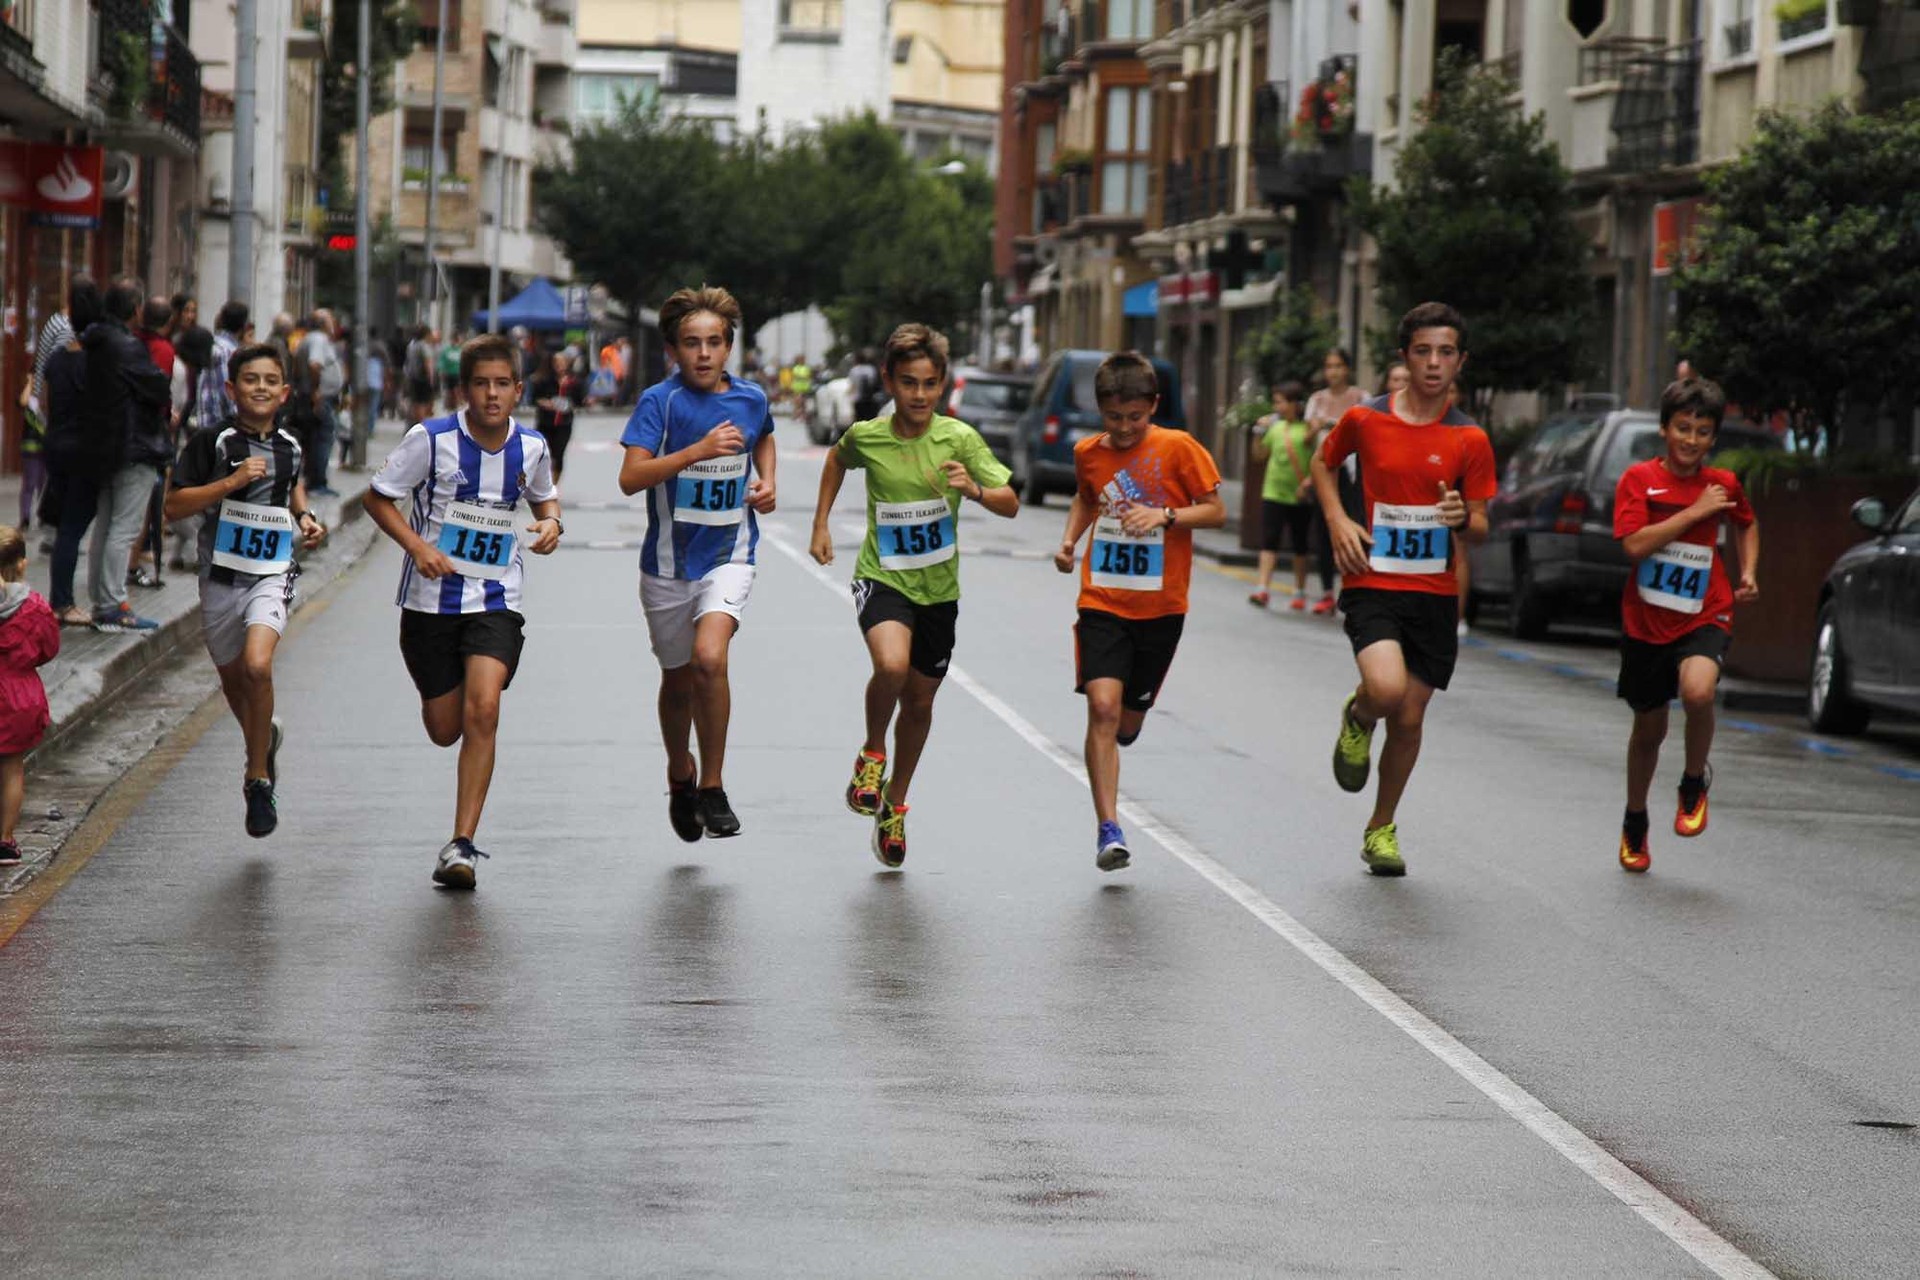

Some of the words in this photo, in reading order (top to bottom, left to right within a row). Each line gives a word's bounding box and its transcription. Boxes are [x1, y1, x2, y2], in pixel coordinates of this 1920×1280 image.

[691, 479, 737, 510] 150
[226, 508, 260, 521] ZUNBELTZ
[451, 510, 485, 525] ZUNBELTZ
[229, 526, 280, 560] 159
[451, 529, 504, 565] 155
[892, 520, 943, 555] 158
[1385, 527, 1435, 560] 151
[1099, 542, 1150, 576] 156
[1648, 561, 1702, 599] 144
